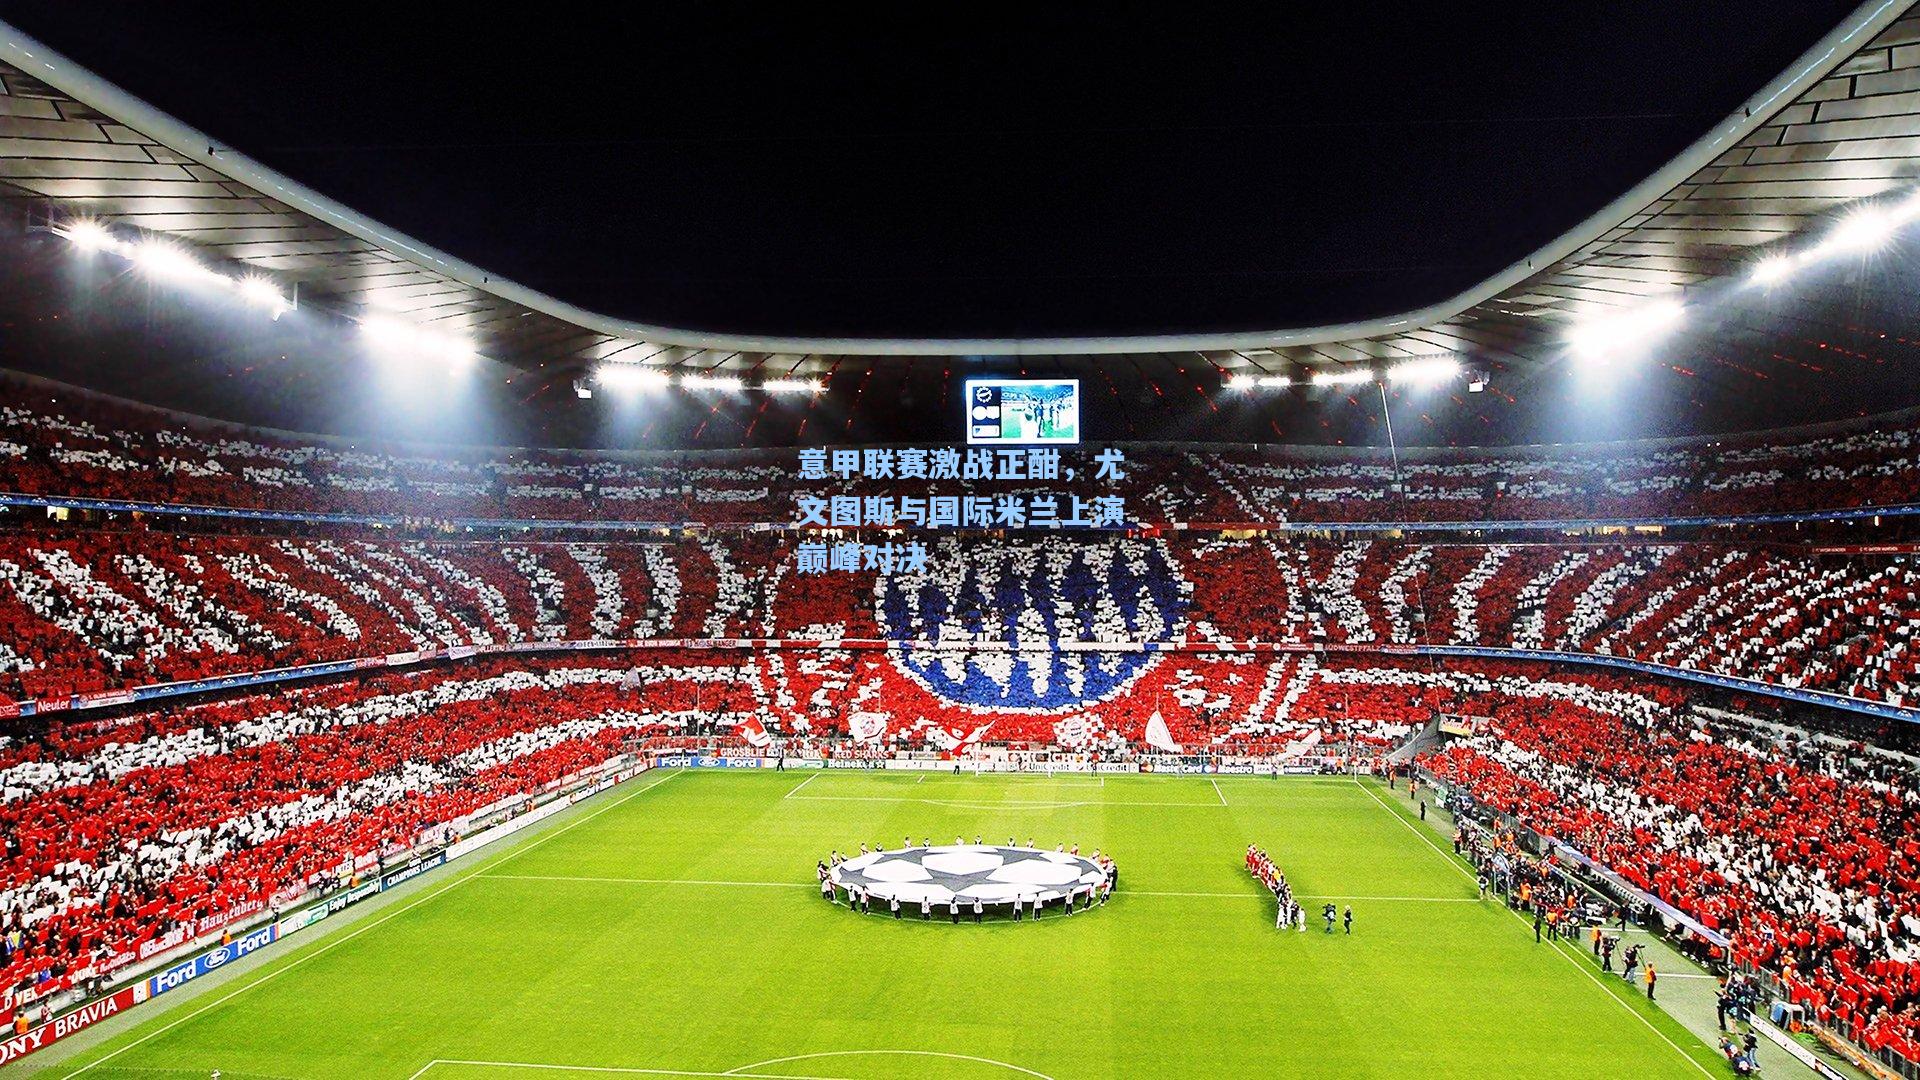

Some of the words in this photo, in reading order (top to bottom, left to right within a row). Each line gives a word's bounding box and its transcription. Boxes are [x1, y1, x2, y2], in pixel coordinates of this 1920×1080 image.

[661, 757, 691, 767] Ford
[726, 757, 757, 767] Ford
[835, 750, 853, 759] RED
[387, 863, 421, 887] CHAMPIONS
[421, 855, 442, 872] LEAGUE
[329, 897, 347, 912] Enjoy
[237, 928, 271, 956] Ford
[156, 959, 197, 993] Ford
[0, 1026, 46, 1065] ONY
[54, 996, 118, 1038] BRAVIA
